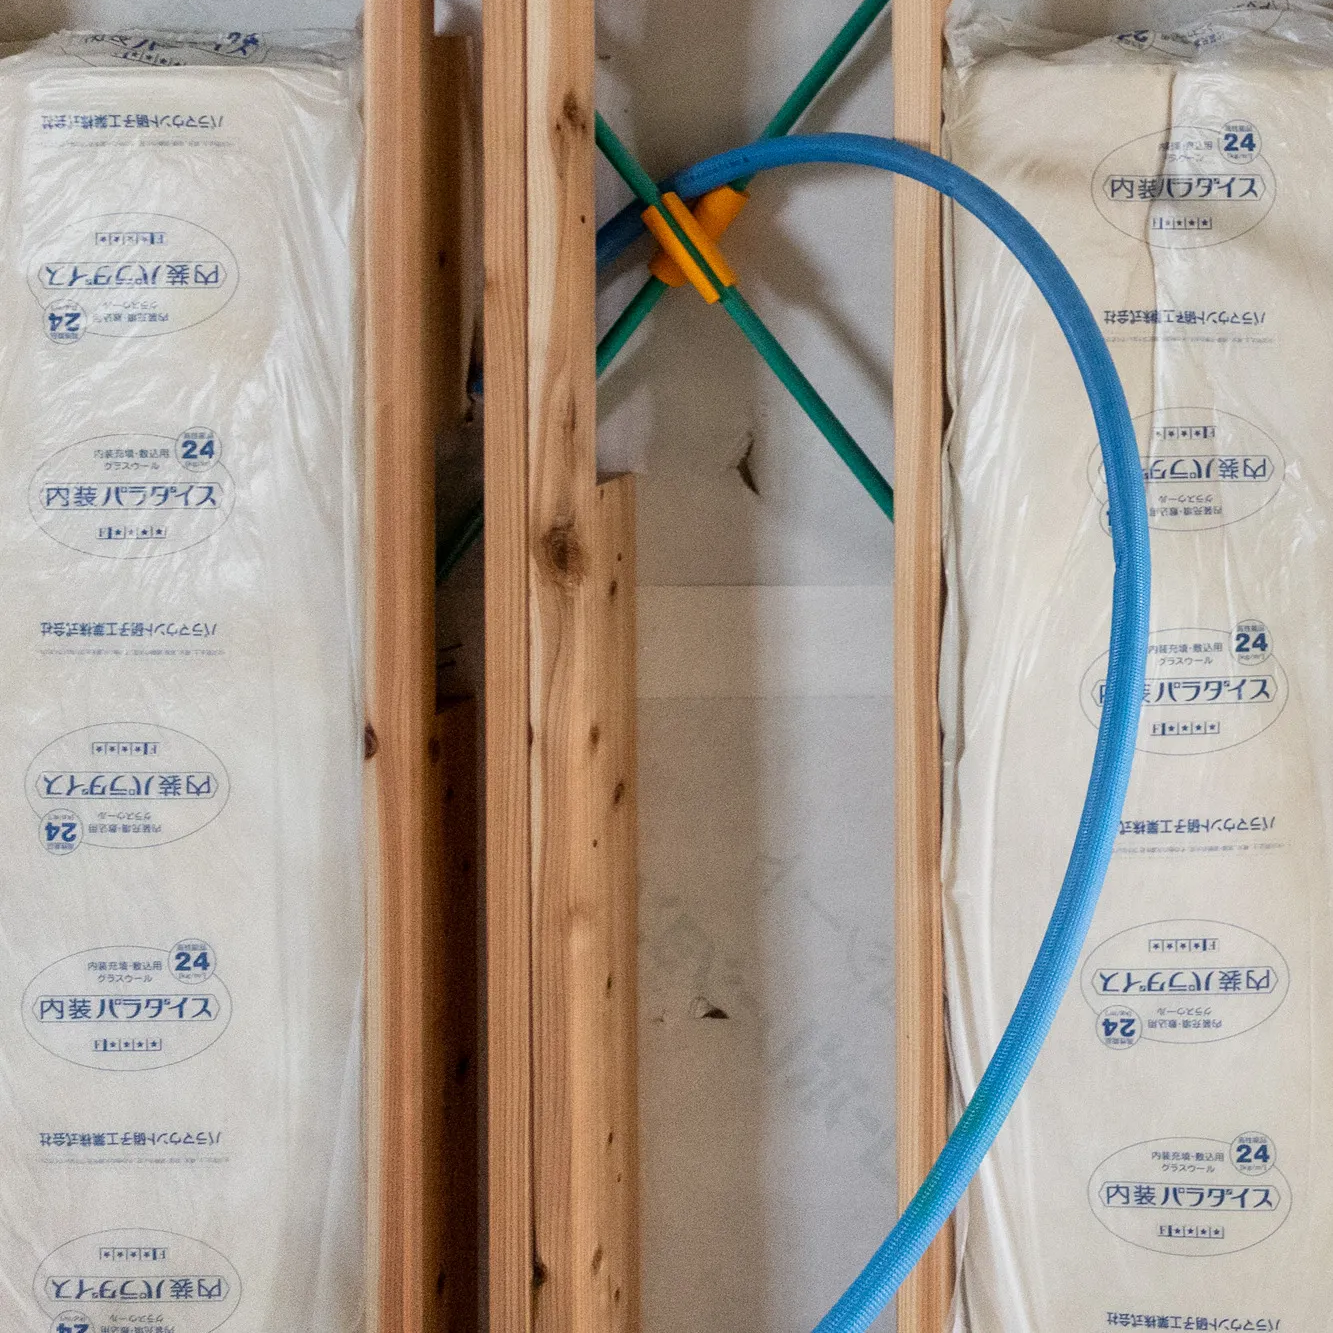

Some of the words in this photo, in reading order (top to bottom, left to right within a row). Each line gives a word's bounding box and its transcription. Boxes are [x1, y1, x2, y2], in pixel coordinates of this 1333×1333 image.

[1223, 133, 1256, 152] 24
[46, 264, 220, 287] 内装パラダイス
[48, 313, 82, 332] 24
[181, 440, 215, 460] 24
[46, 486, 217, 508] 内装パラダイス
[1235, 633, 1268, 653] 24
[43, 774, 212, 797] 内装パラダイス
[45, 822, 78, 842] 24
[175, 952, 210, 973] 24
[1100, 970, 1271, 992] 内装パラダイス
[40, 998, 212, 1020] 内装パラダイス
[1102, 1018, 1136, 1037] 24
[1236, 1145, 1270, 1164] 24
[1106, 1185, 1273, 1208] 内装パラダイス
[52, 1279, 222, 1299] 内装パラダイス
